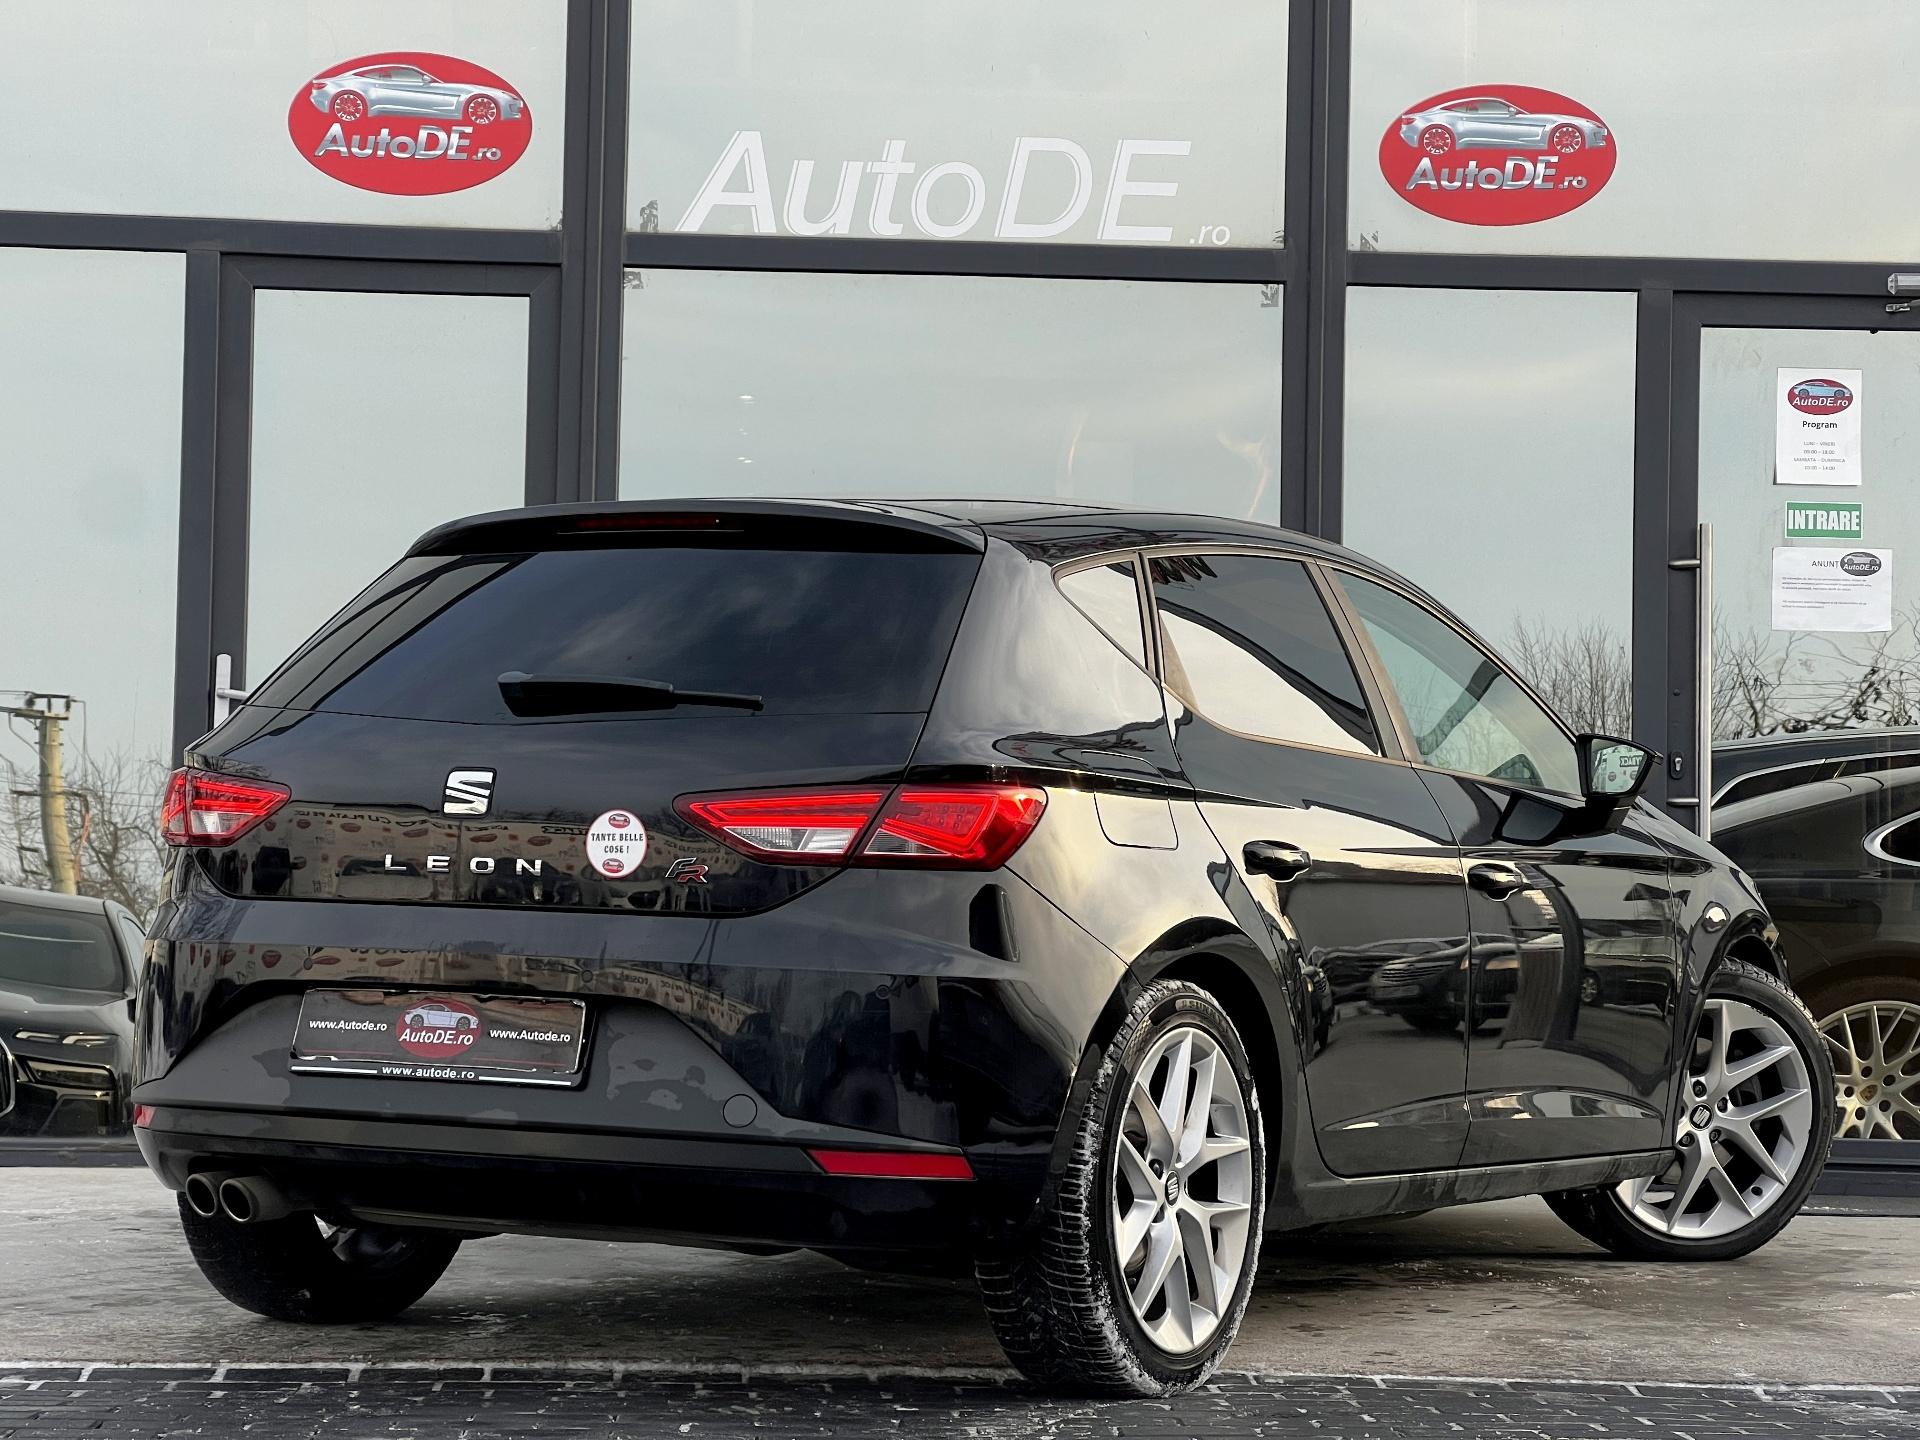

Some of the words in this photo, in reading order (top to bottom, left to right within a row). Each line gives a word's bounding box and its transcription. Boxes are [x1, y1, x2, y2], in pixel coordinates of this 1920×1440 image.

[1792, 397, 1849, 407] AutoDE.ro
[1802, 420, 1838, 430] Program
[1788, 509, 1860, 531] INTRARE
[591, 832, 617, 842] TANTE
[619, 833, 644, 842] BELLE
[604, 845, 624, 854] COSE
[384, 854, 542, 877] LEON
[309, 1019, 388, 1032] www.Autode.ro
[398, 1028, 474, 1046] AutoDE.ro
[489, 1028, 571, 1043] www.Autode.ro
[382, 1065, 475, 1080] www.autode.ro
